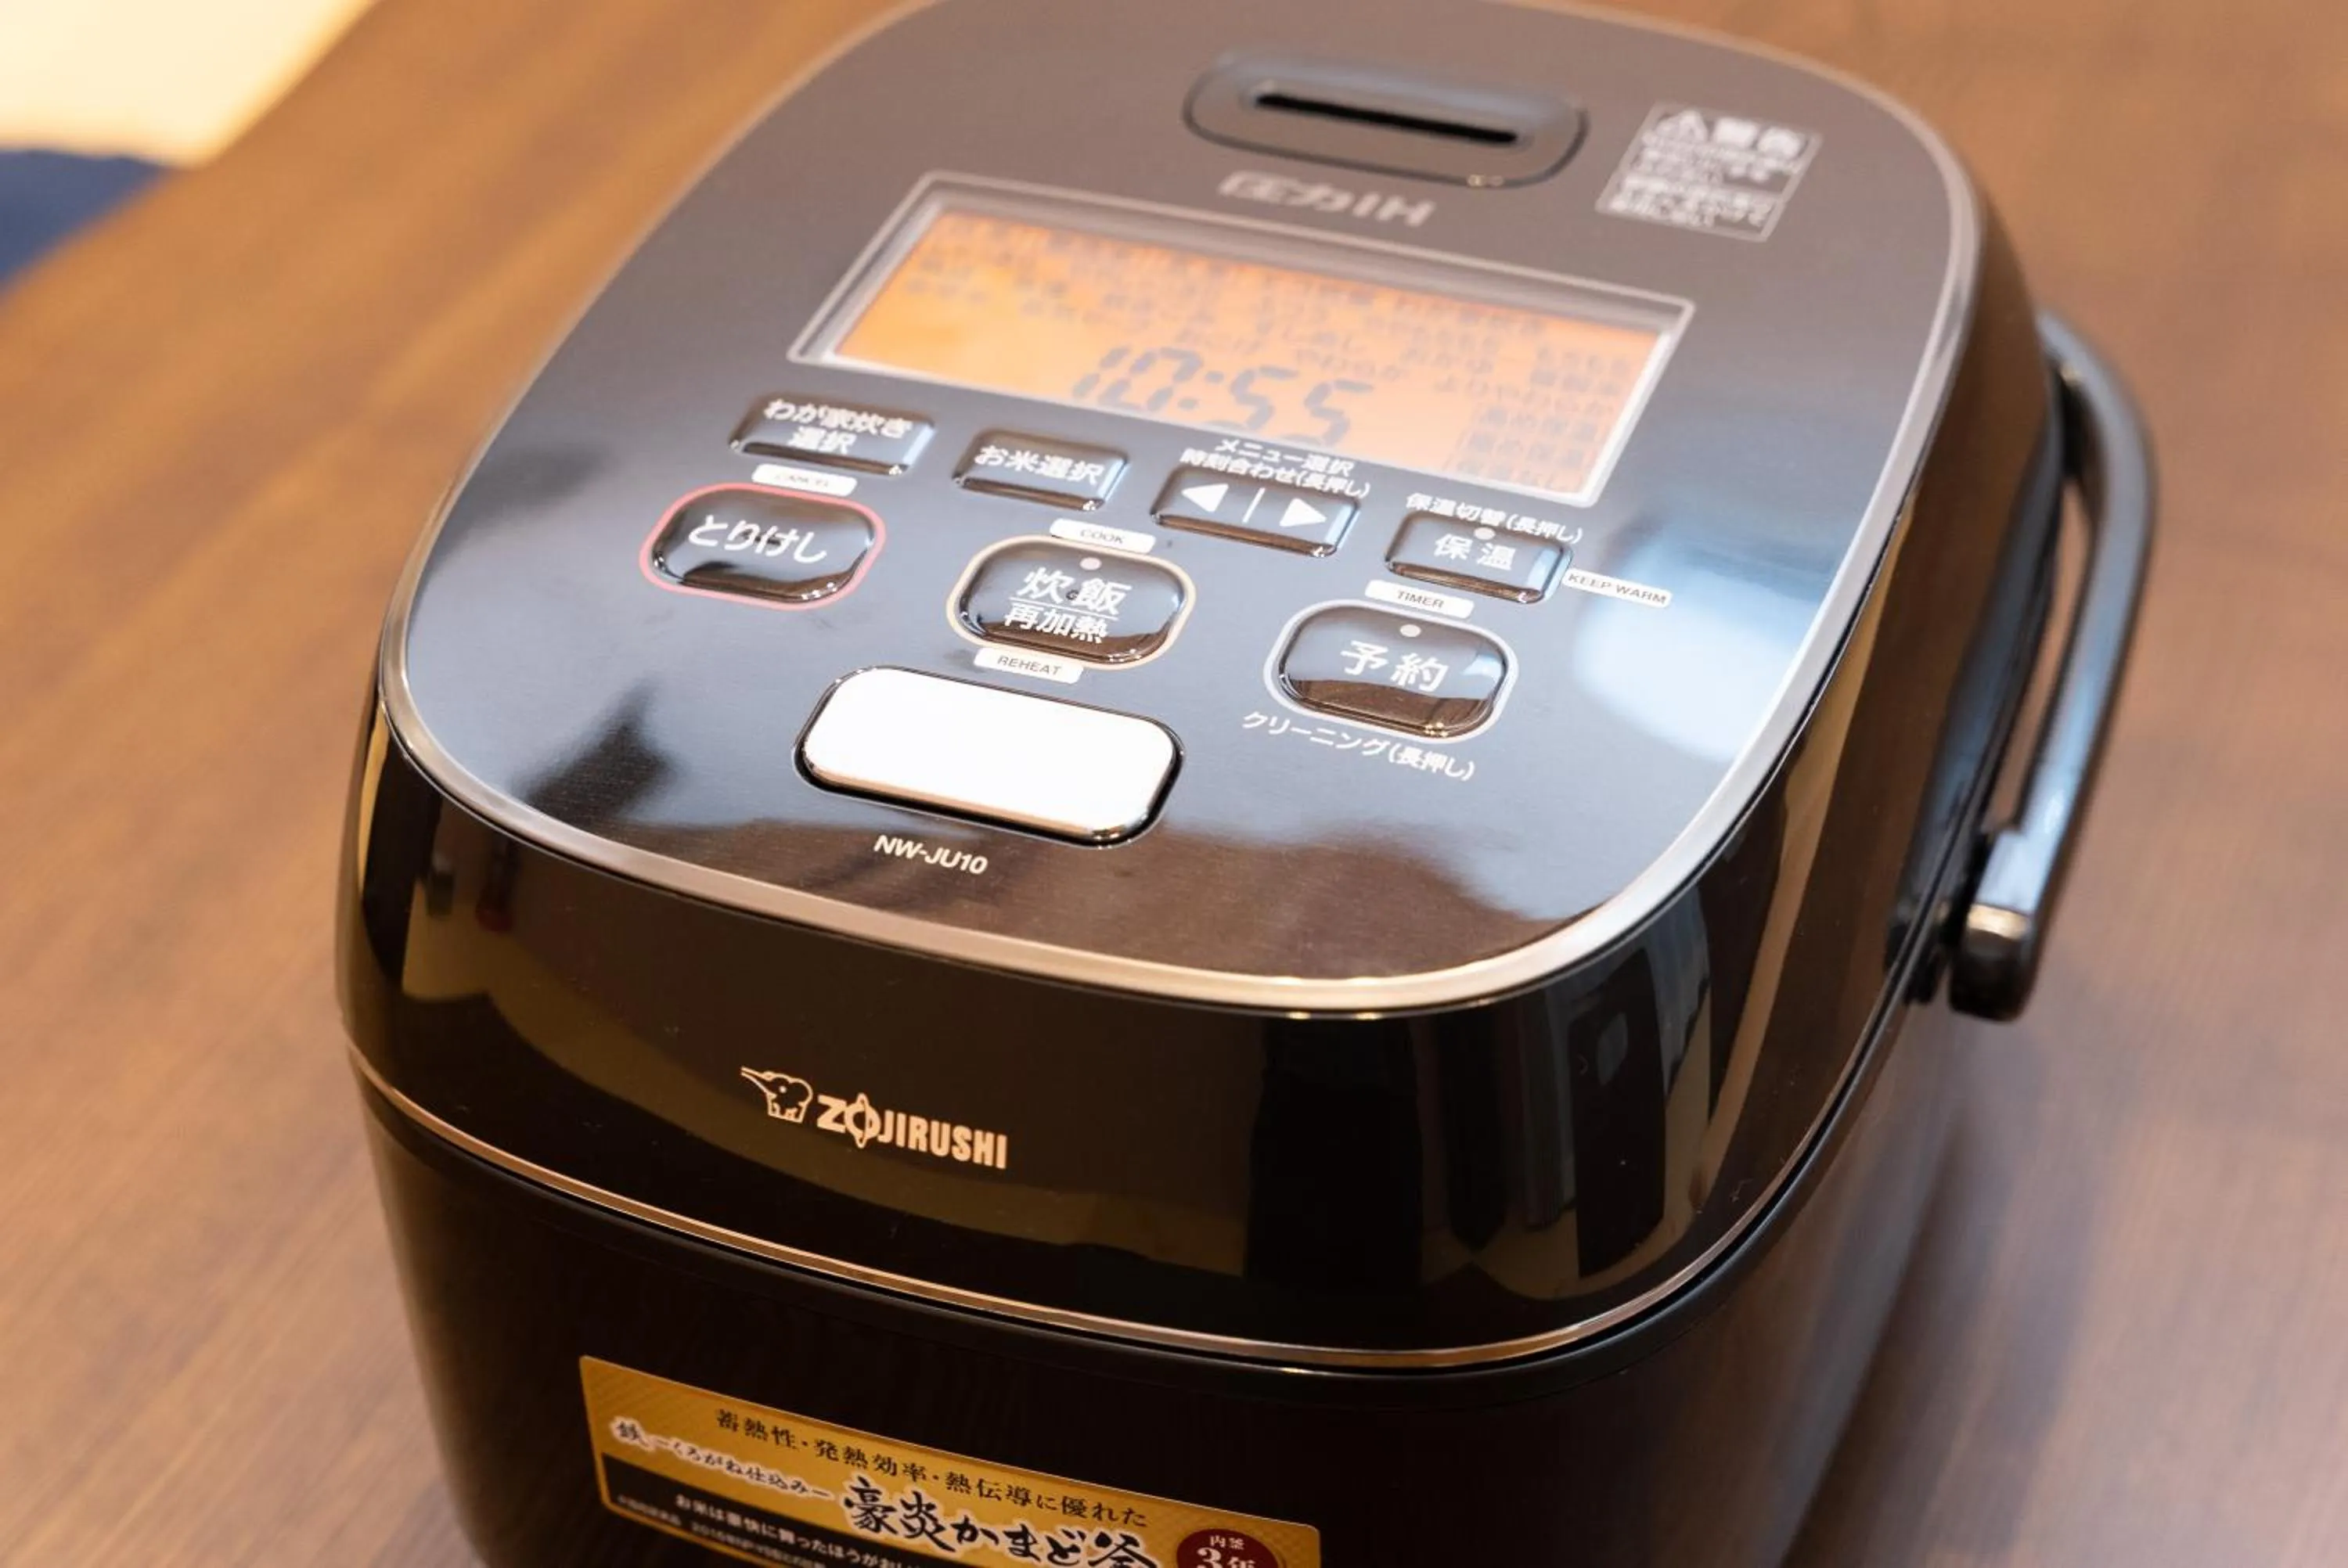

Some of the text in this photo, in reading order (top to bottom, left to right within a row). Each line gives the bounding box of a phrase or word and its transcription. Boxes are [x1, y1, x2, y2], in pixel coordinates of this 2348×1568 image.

[1071, 346, 1375, 447] 10:55
[787, 425, 858, 455] 選択
[1215, 438, 1356, 476] メニュー選択
[974, 444, 1105, 485] お米選択
[1179, 447, 1371, 499] 時刻合わせ(長押し)
[689, 514, 827, 563] とりけし
[1080, 529, 1126, 545] COOK
[1406, 492, 1584, 545] 保温切替(長押し)
[1434, 533, 1517, 571] 保温
[1017, 566, 1133, 615] 炊飯
[1396, 589, 1445, 610] TIMER
[1568, 574, 1668, 605] KEEP WARM
[1004, 602, 1110, 644] 再加熱
[996, 654, 1062, 675] REHEAT
[1340, 640, 1449, 692] 予約
[1242, 710, 1475, 781] クリーニング(長押し)
[873, 834, 989, 875] NW-JU10
[816, 1092, 1008, 1170] ZOJIRUSHI
